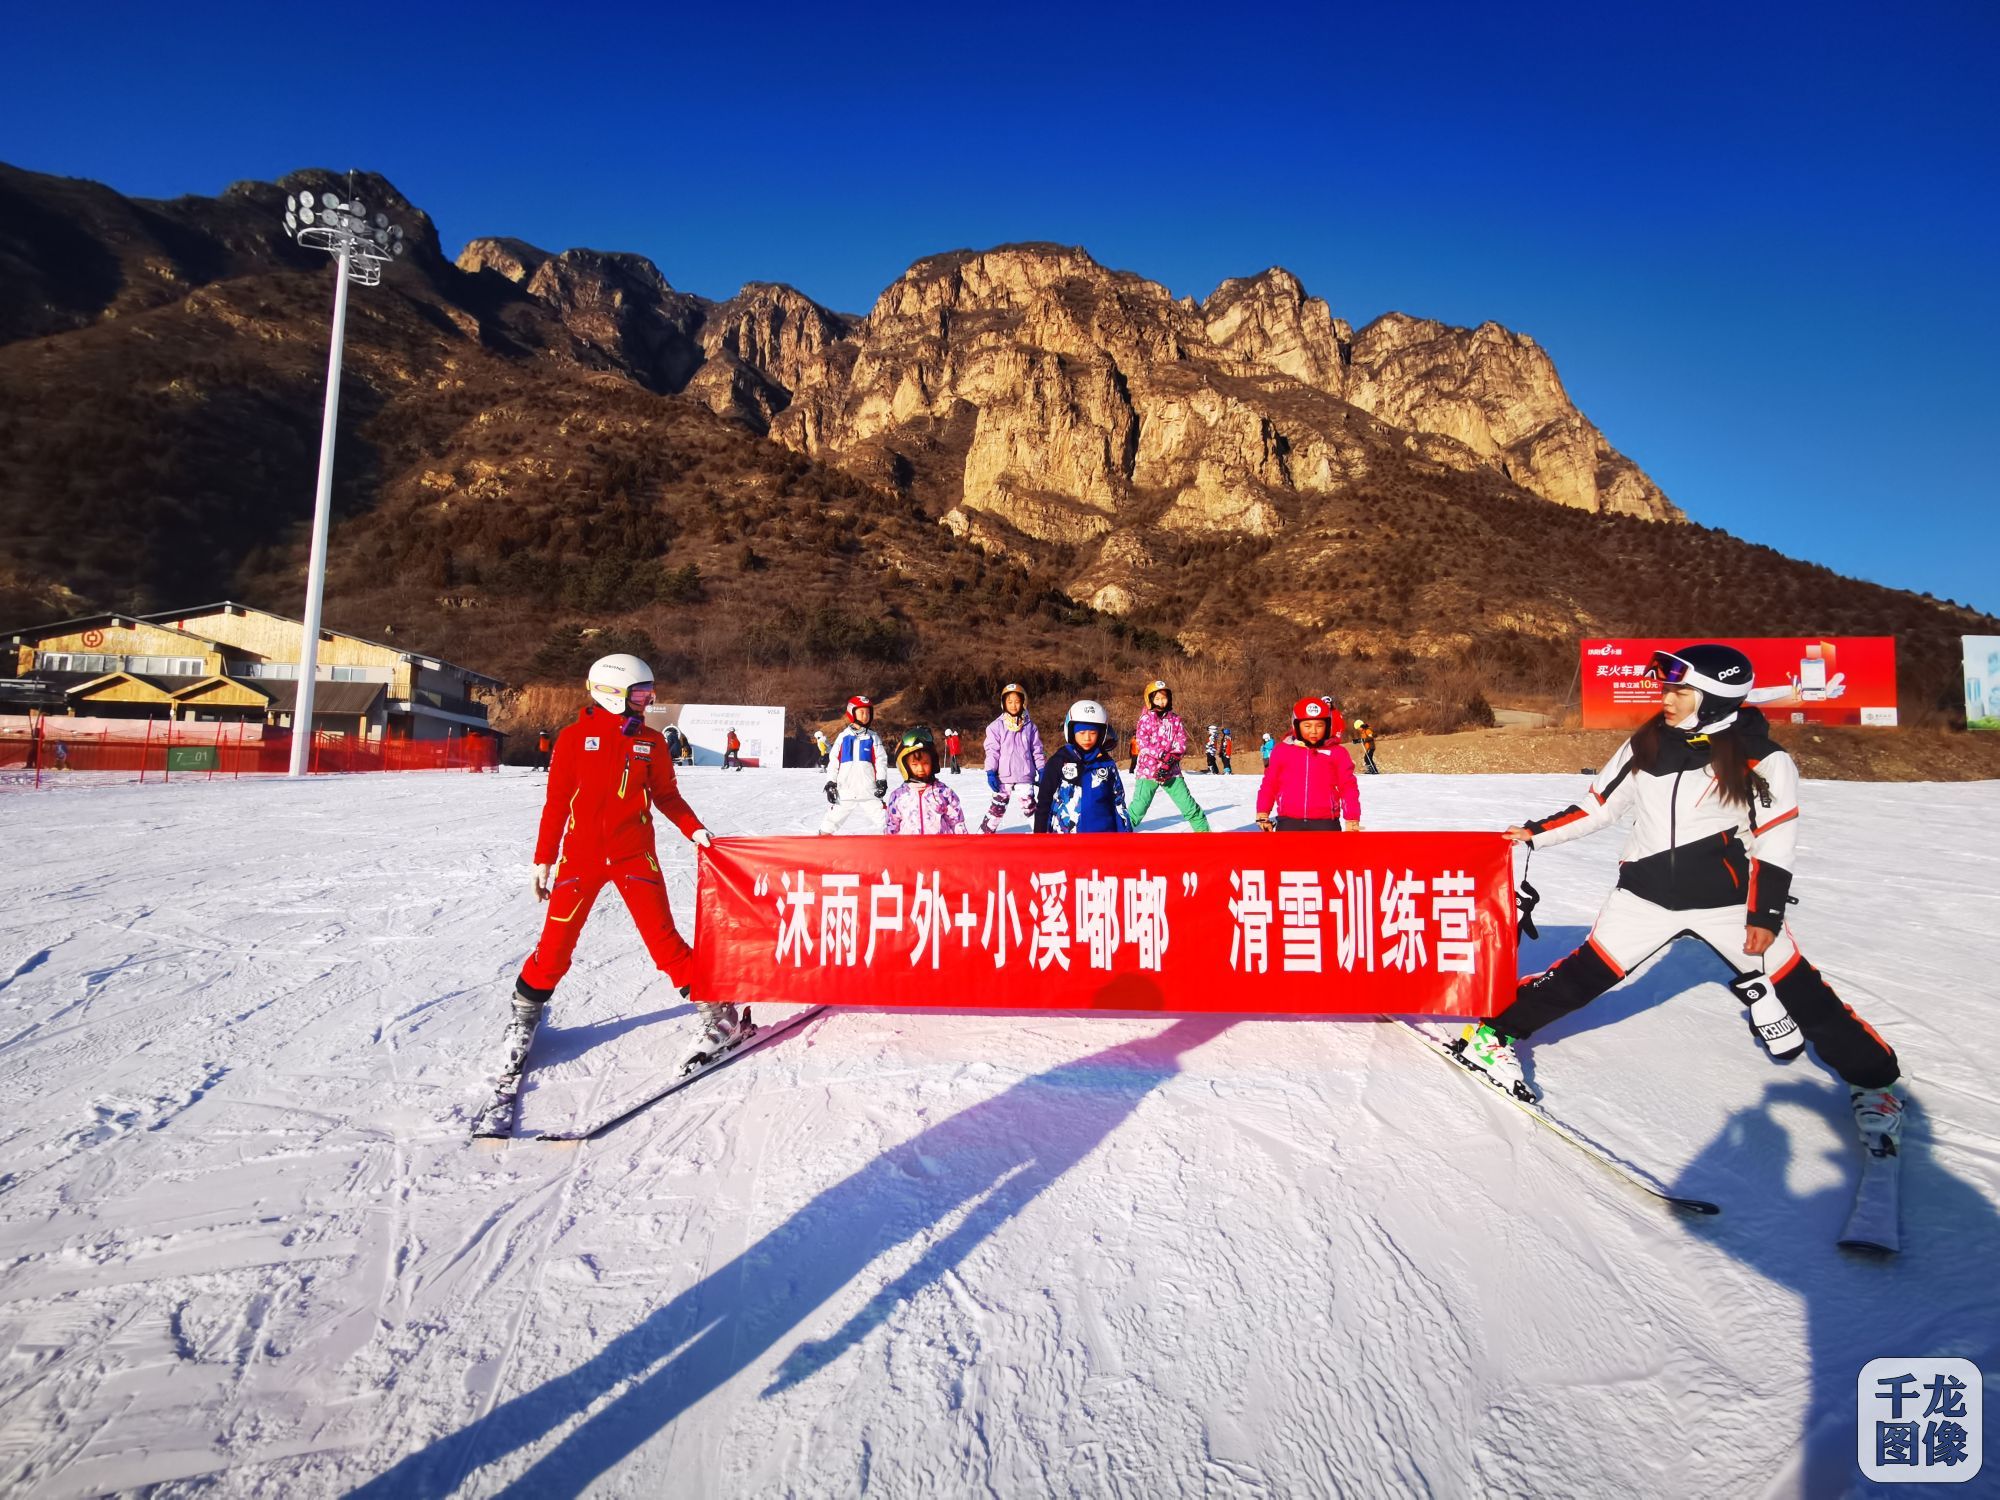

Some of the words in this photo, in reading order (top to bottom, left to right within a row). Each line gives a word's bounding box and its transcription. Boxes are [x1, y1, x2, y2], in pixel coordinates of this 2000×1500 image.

[1228, 868, 1476, 974] 滑雪训练营
